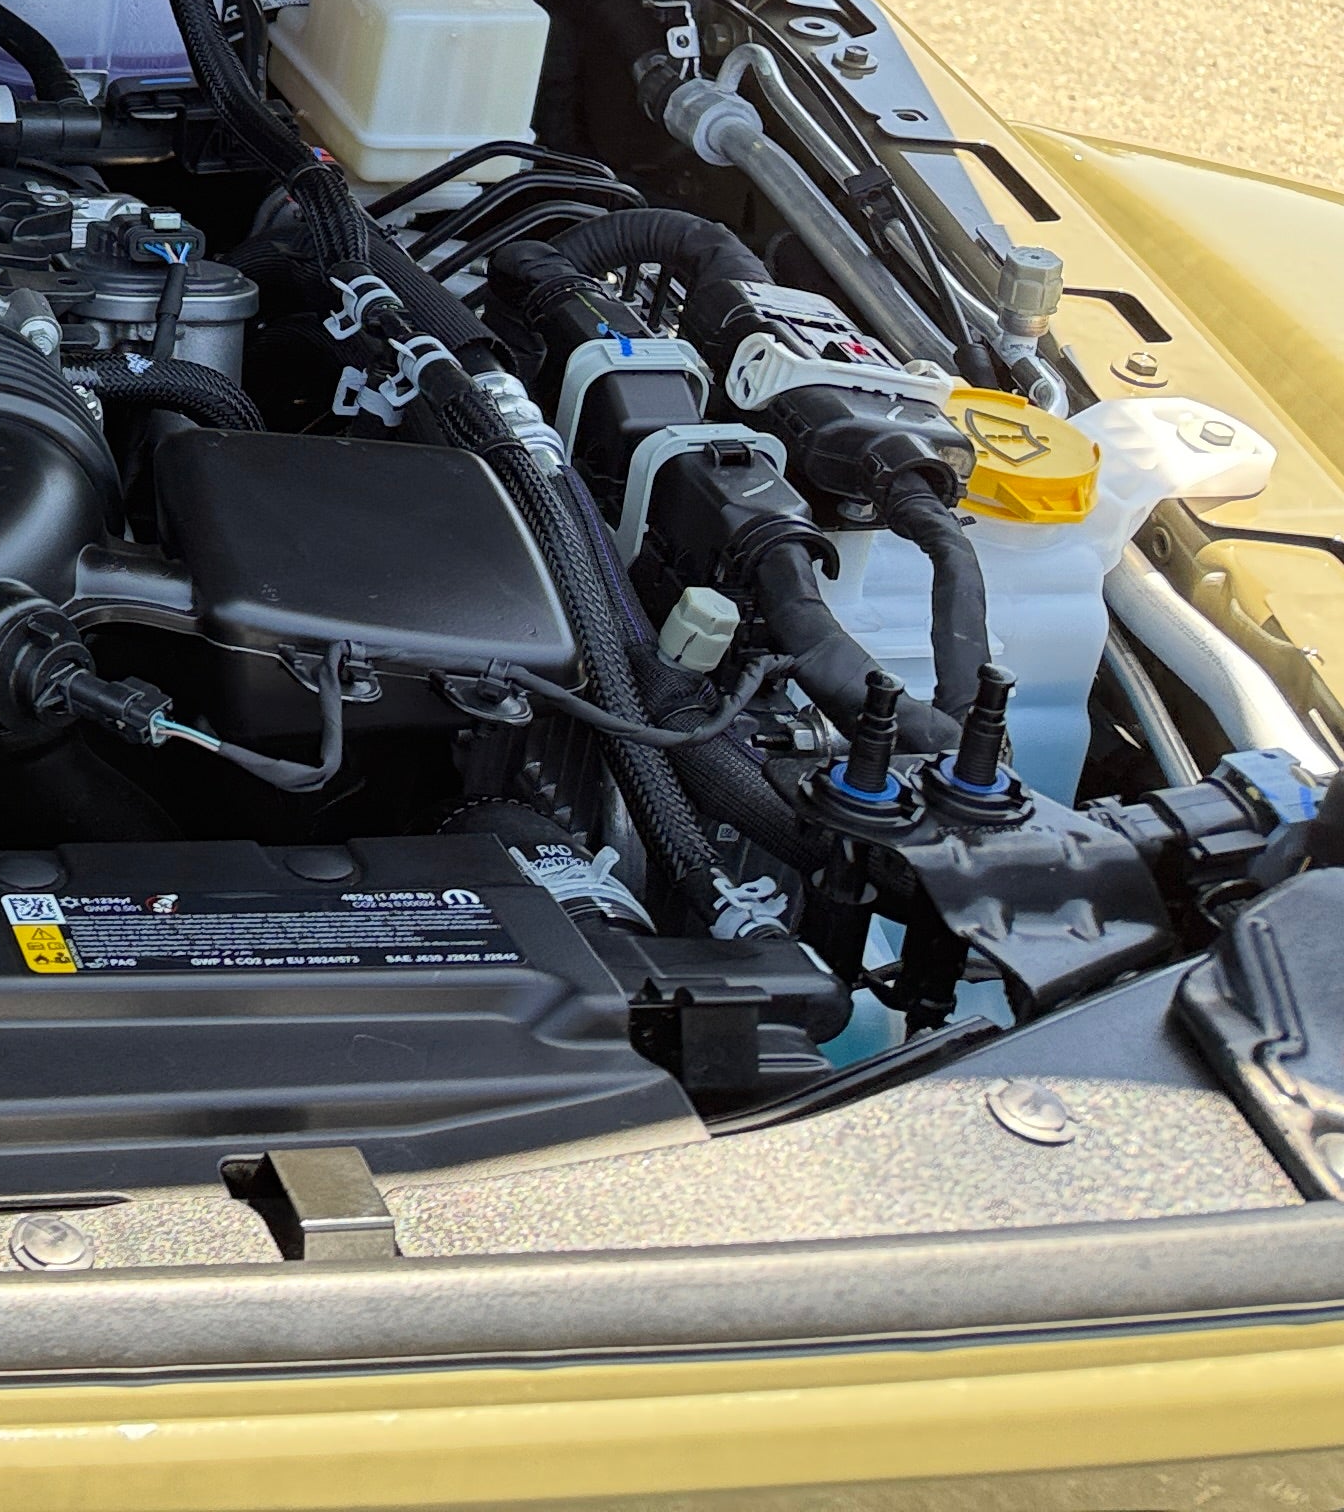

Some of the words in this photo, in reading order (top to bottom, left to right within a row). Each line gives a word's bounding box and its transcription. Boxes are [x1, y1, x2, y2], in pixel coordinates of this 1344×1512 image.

[535, 844, 572, 857] RAD
[83, 904, 112, 913] GWP
[110, 958, 137, 967] PAG
[190, 958, 221, 966] GWP
[223, 957, 234, 966] &
[235, 957, 263, 966] CO2
[264, 958, 285, 966] per
[286, 956, 305, 965] EU
[385, 954, 413, 963] SAE
